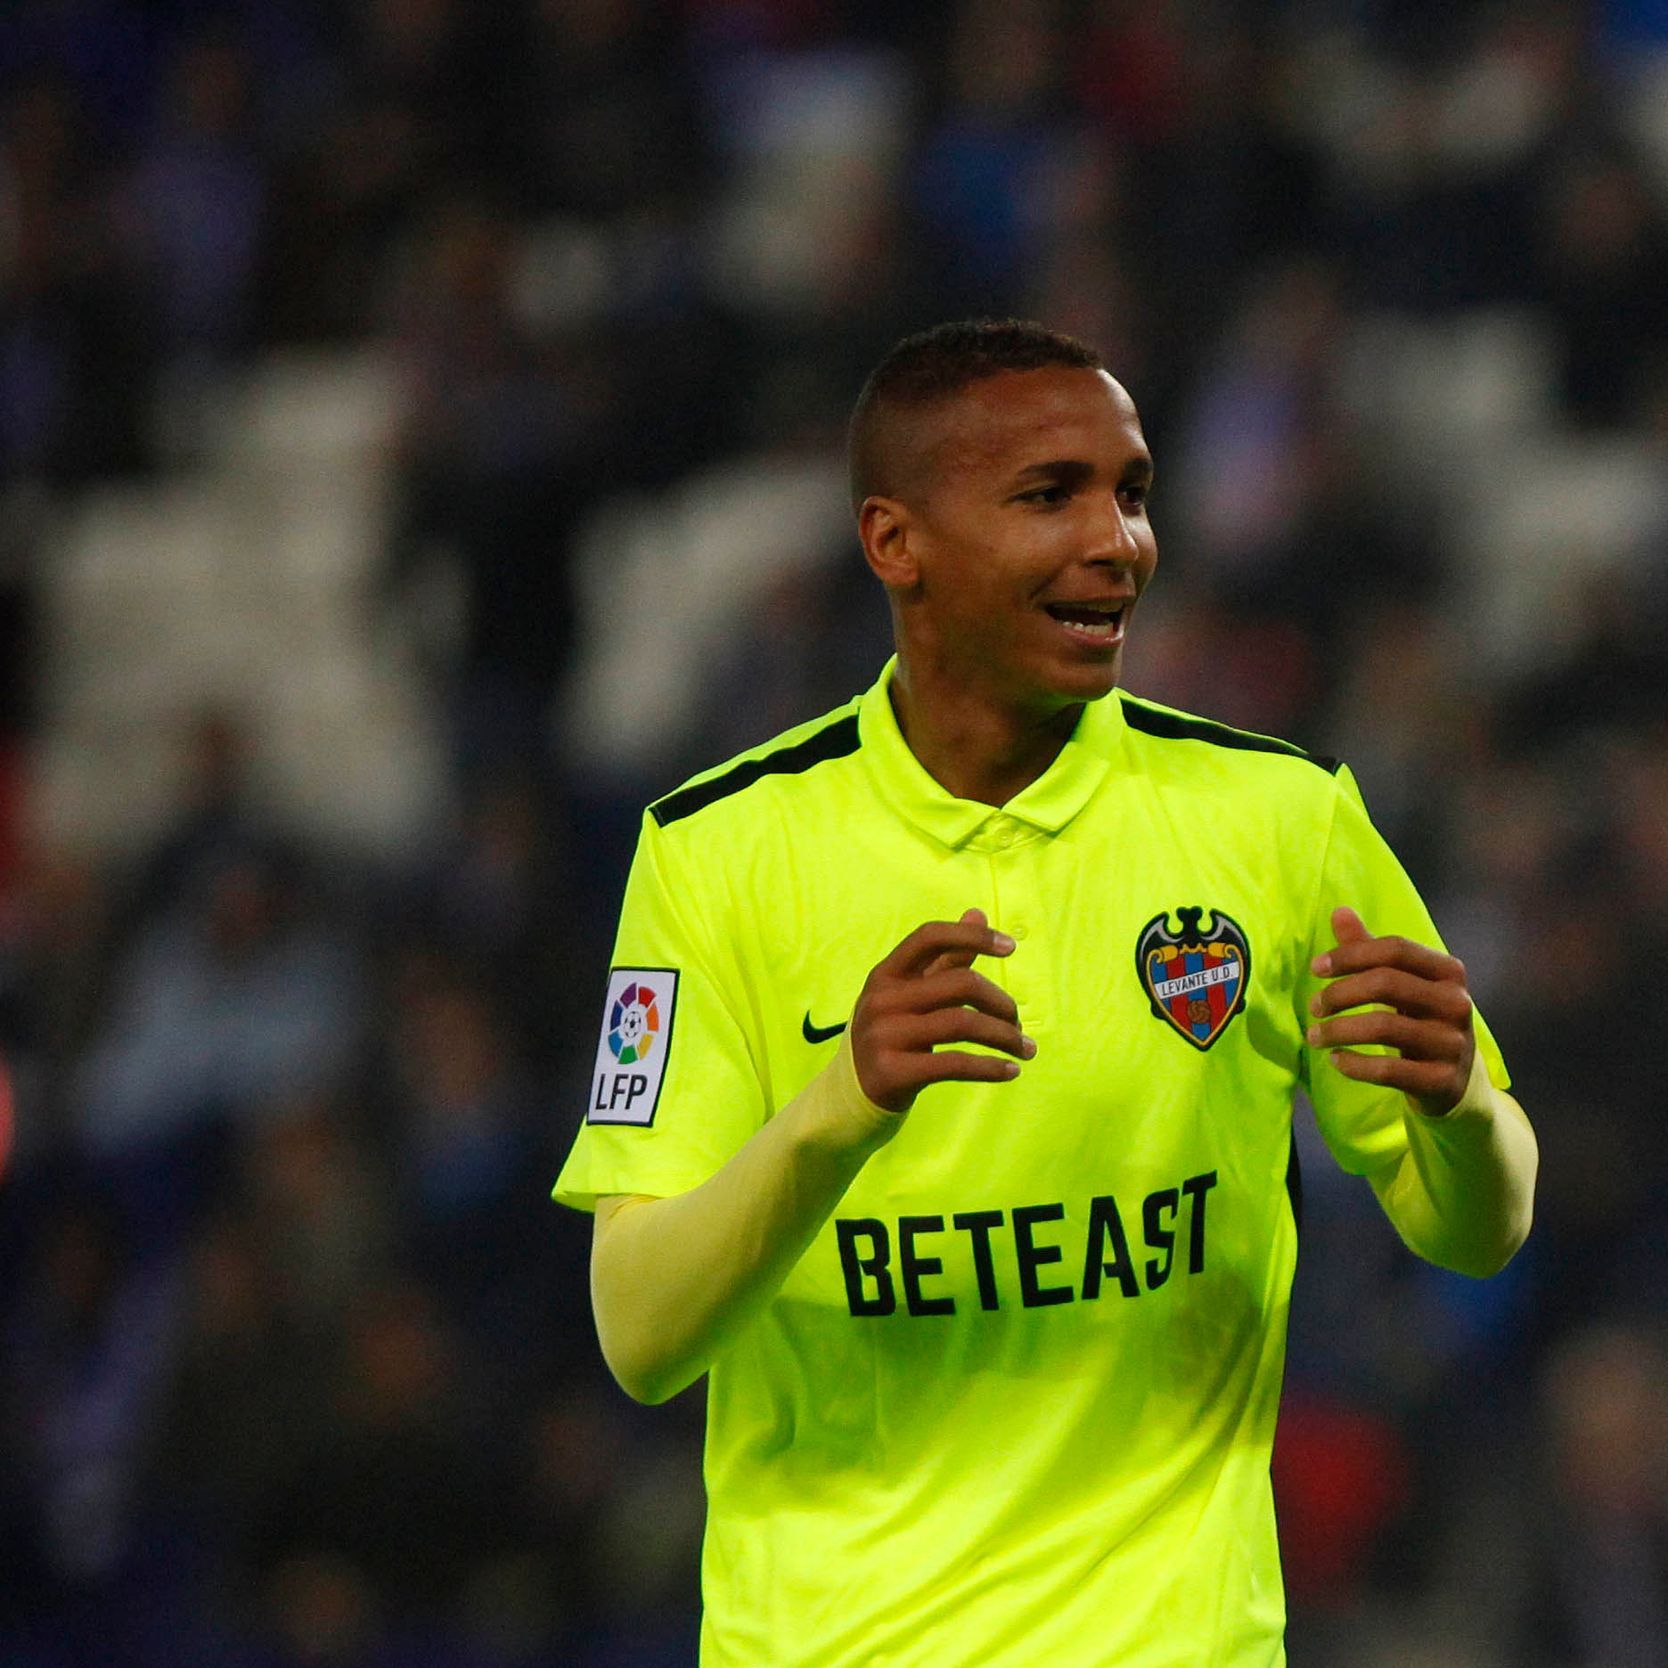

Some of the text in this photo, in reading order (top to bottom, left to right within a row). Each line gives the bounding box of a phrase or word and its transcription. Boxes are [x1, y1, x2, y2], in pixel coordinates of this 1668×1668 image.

[1161, 974, 1208, 996] LEVANTE
[595, 1073, 648, 1110] LFP
[834, 1171, 1218, 1317] BETEAST
